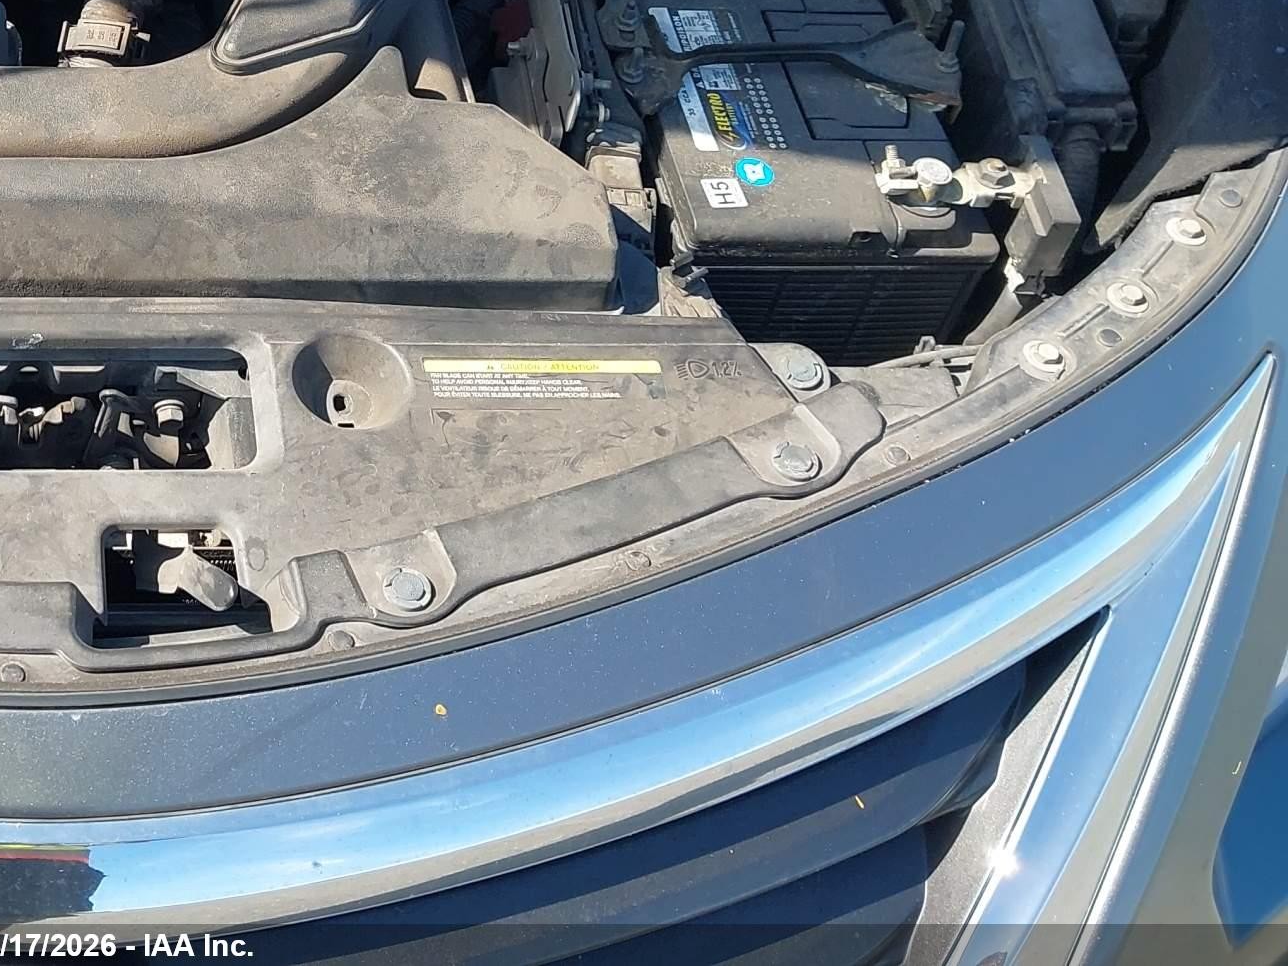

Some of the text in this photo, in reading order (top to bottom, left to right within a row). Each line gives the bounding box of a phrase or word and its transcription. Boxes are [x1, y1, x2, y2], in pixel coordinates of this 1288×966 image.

[706, 92, 733, 131] ELECTRO
[710, 181, 737, 205] H5
[551, 362, 600, 370] ATTENTION
